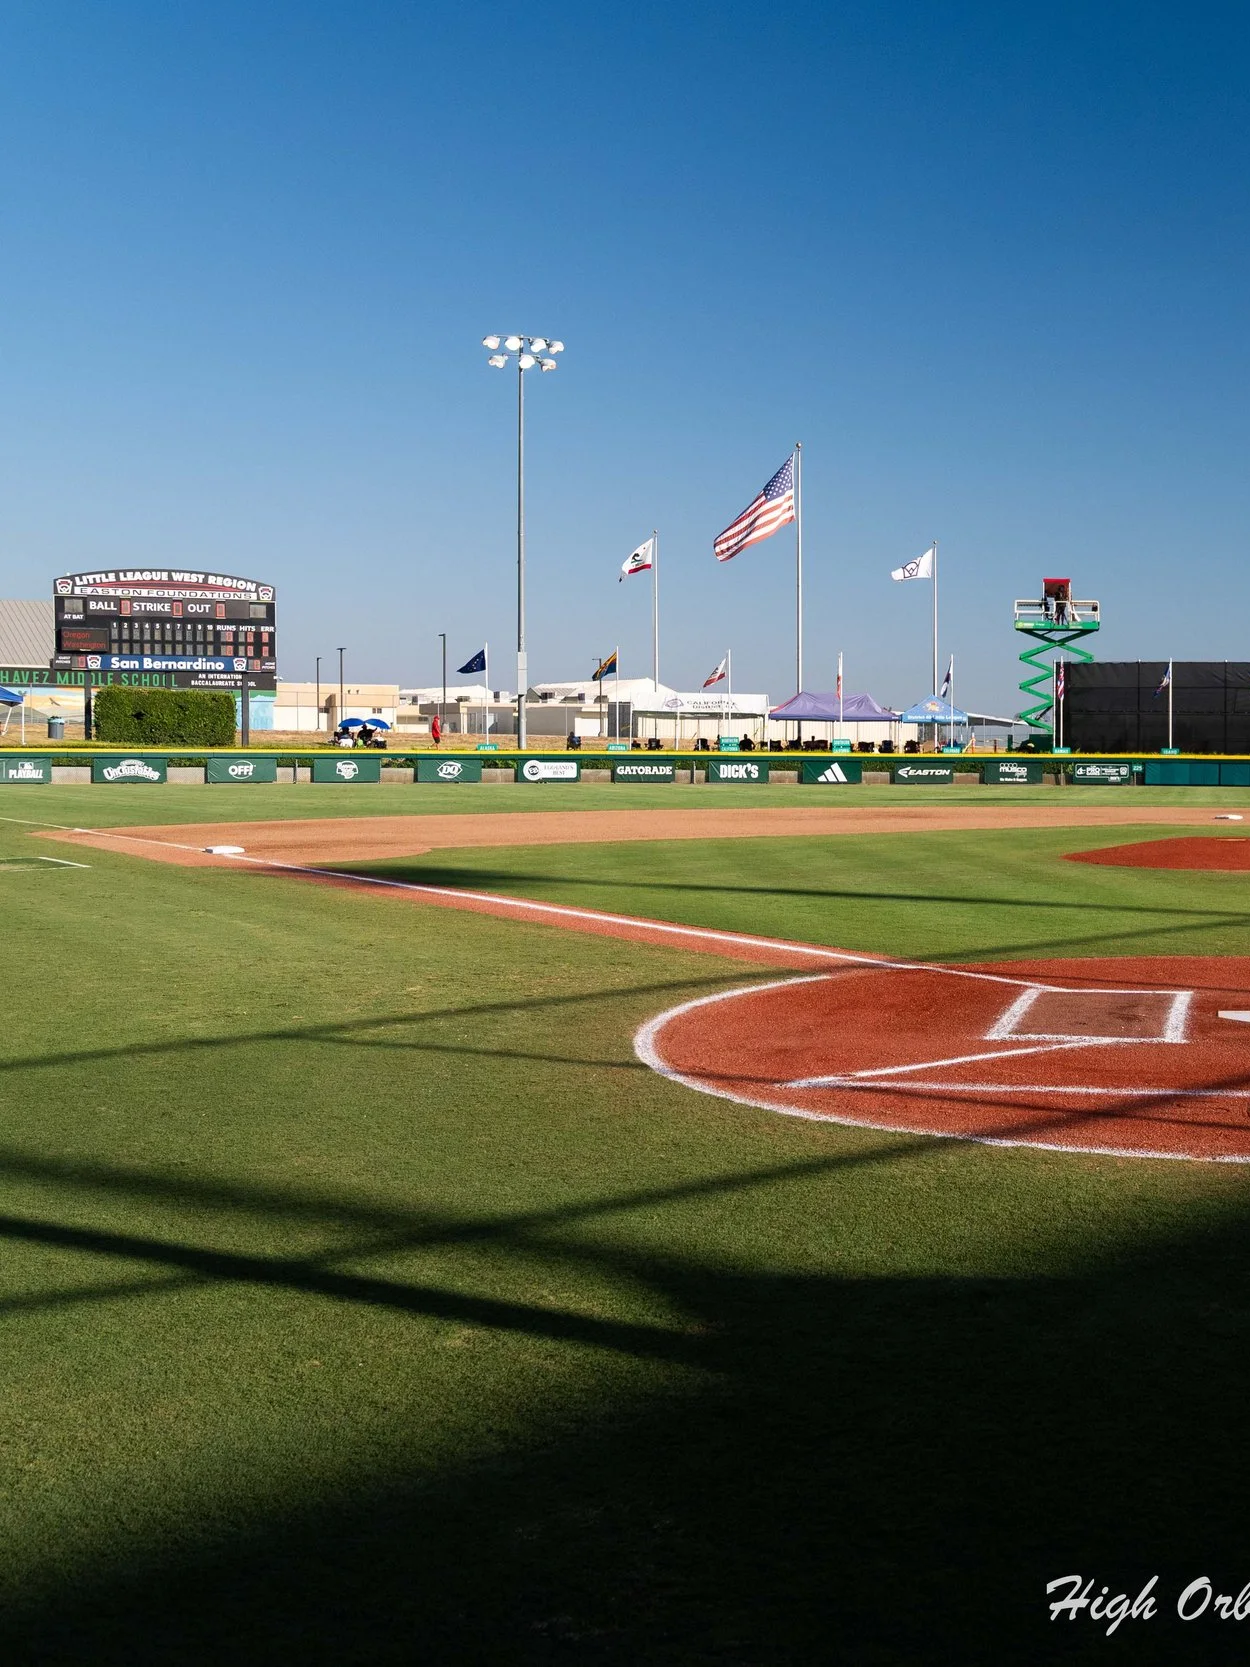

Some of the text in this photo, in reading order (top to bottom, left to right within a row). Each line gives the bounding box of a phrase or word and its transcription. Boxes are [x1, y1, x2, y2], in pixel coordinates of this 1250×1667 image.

[75, 571, 257, 591] LITTLE LEAGUE WEST REGION
[80, 588, 252, 599] EASTON FOUNDATIONS
[90, 601, 117, 611] BALL
[133, 602, 171, 612] STRIKE
[188, 603, 211, 613] OUT
[111, 657, 224, 670] San Bernardino
[0, 670, 50, 684] HAVEZ
[617, 766, 672, 774] GATORADE
[720, 763, 758, 778] DICK'S
